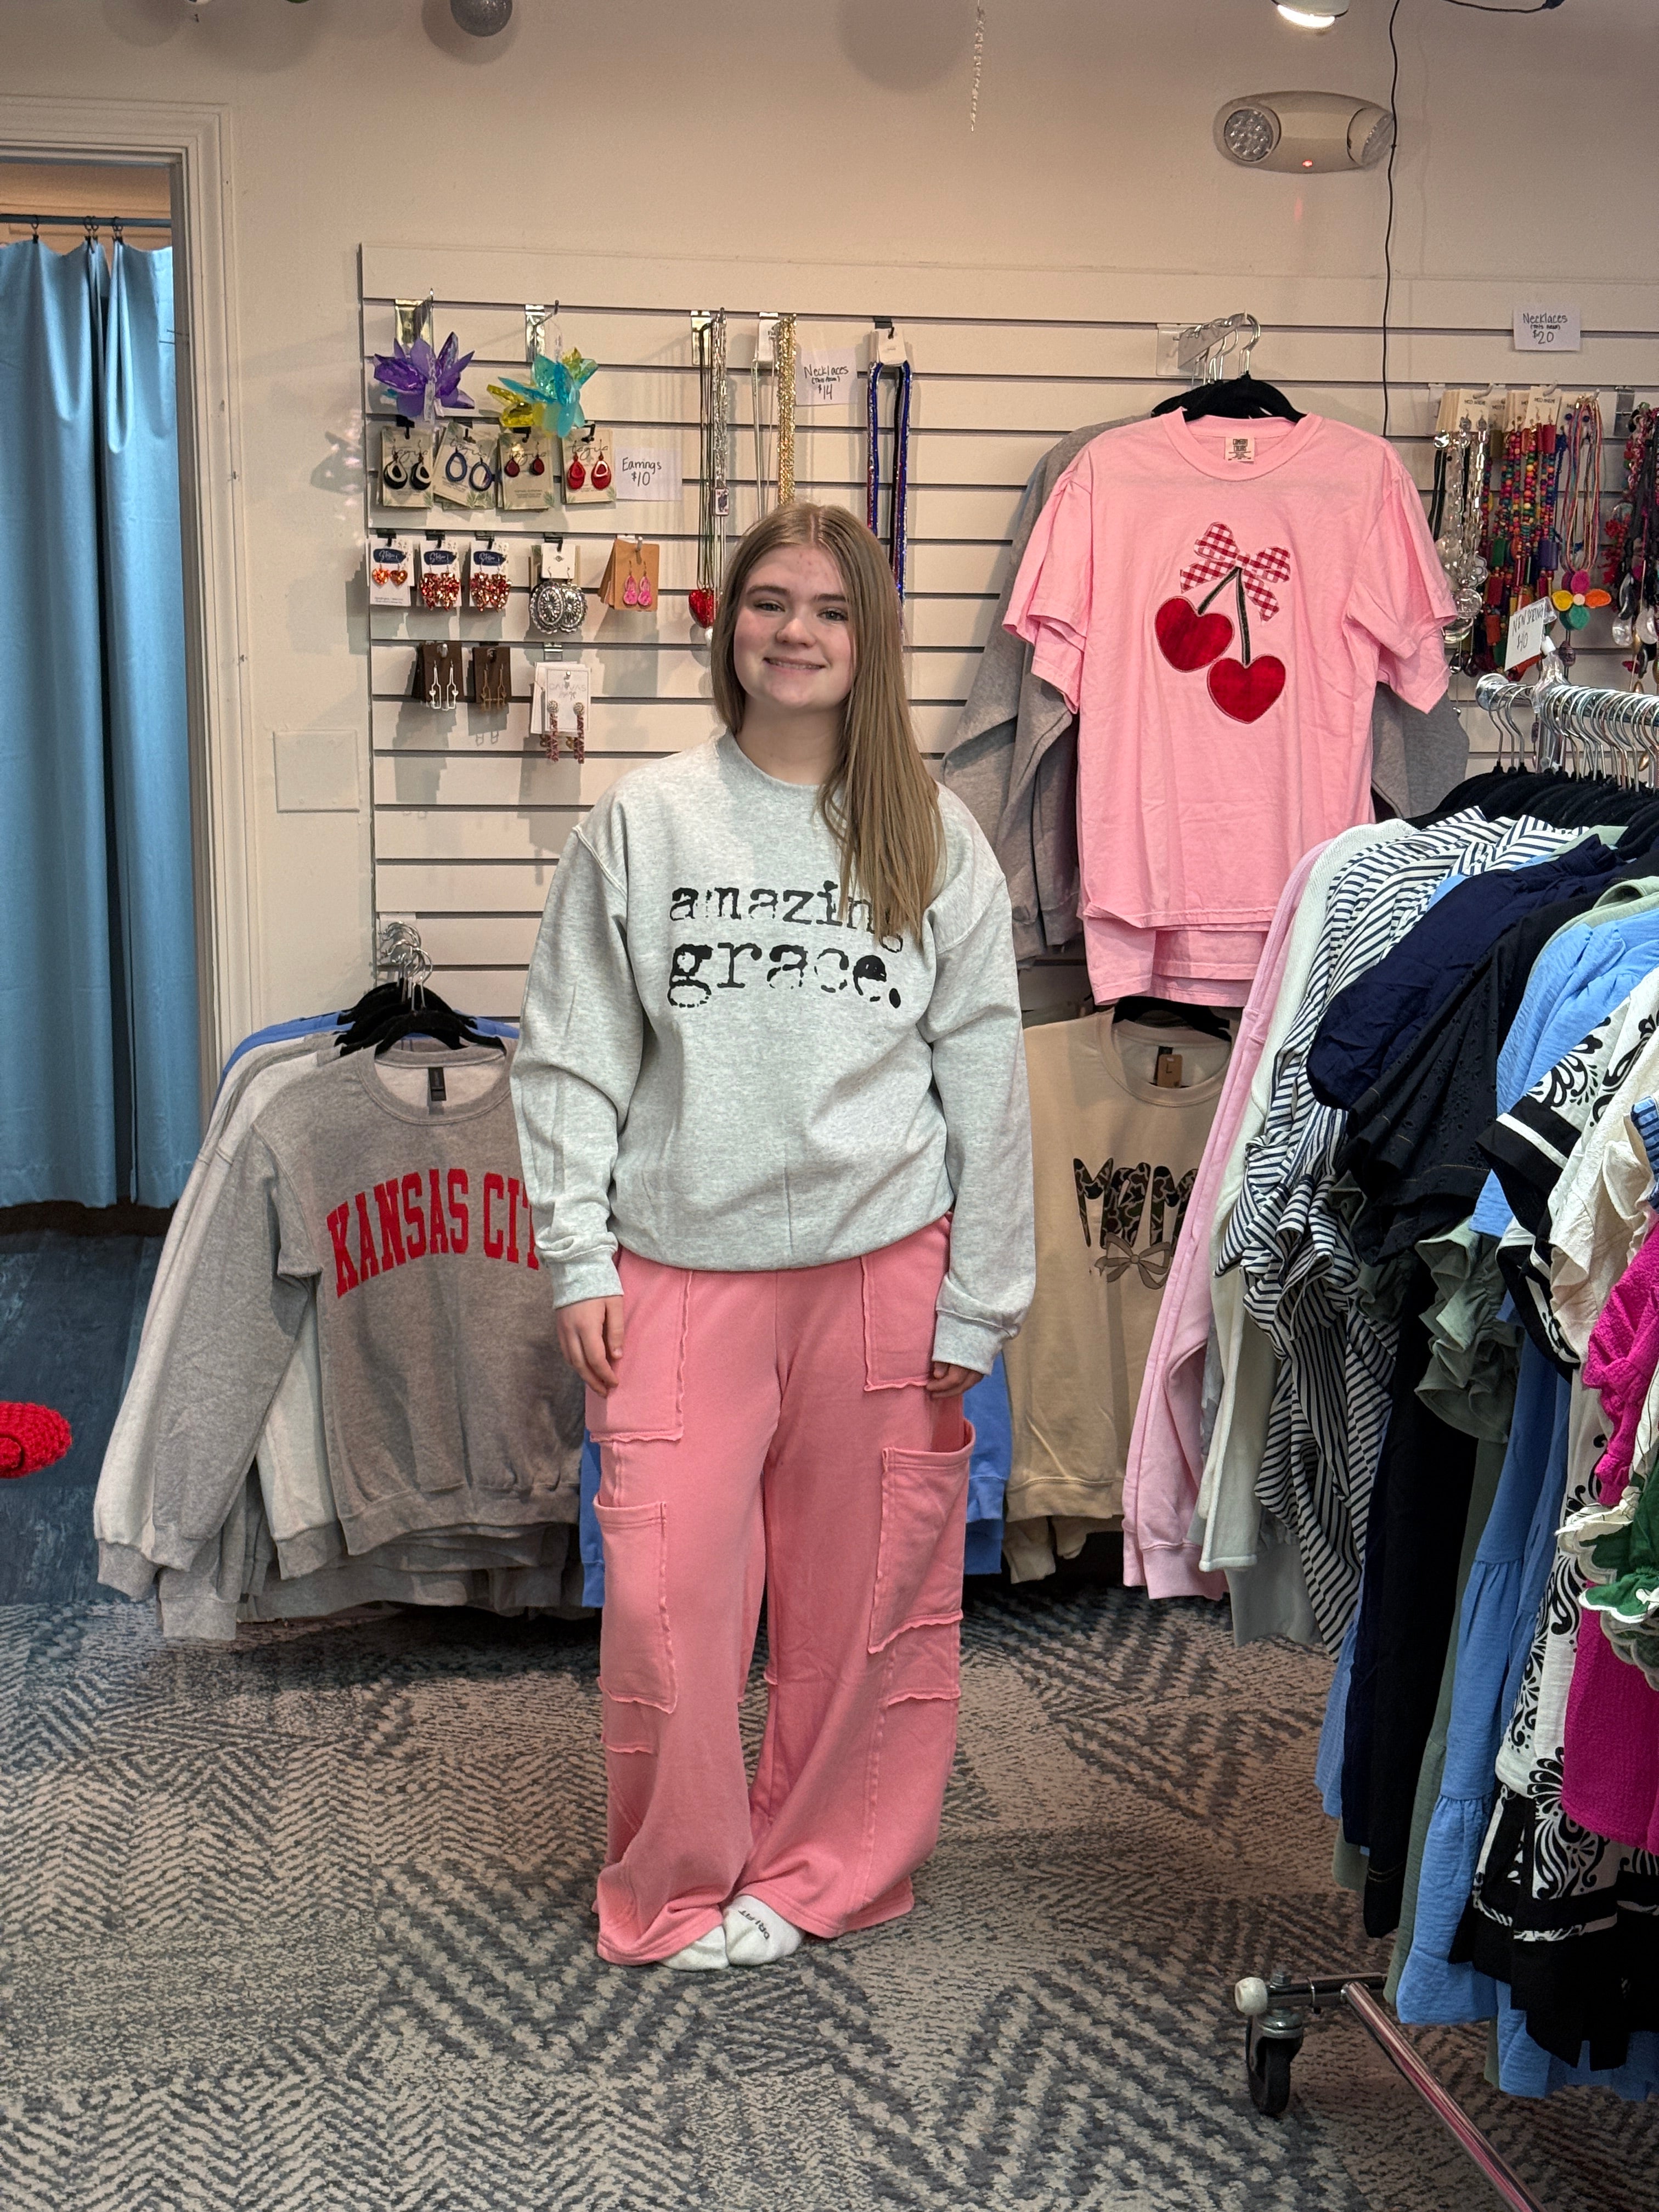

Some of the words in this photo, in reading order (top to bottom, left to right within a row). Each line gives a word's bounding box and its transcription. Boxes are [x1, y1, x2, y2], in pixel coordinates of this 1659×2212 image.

[1523, 313, 1568, 324] Necklaces
[1533, 330, 1554, 345] $20
[804, 364, 849, 379] Necklaces
[818, 383, 833, 400] $14
[631, 471, 650, 487] $10
[326, 1168, 469, 1299] KANSAS
